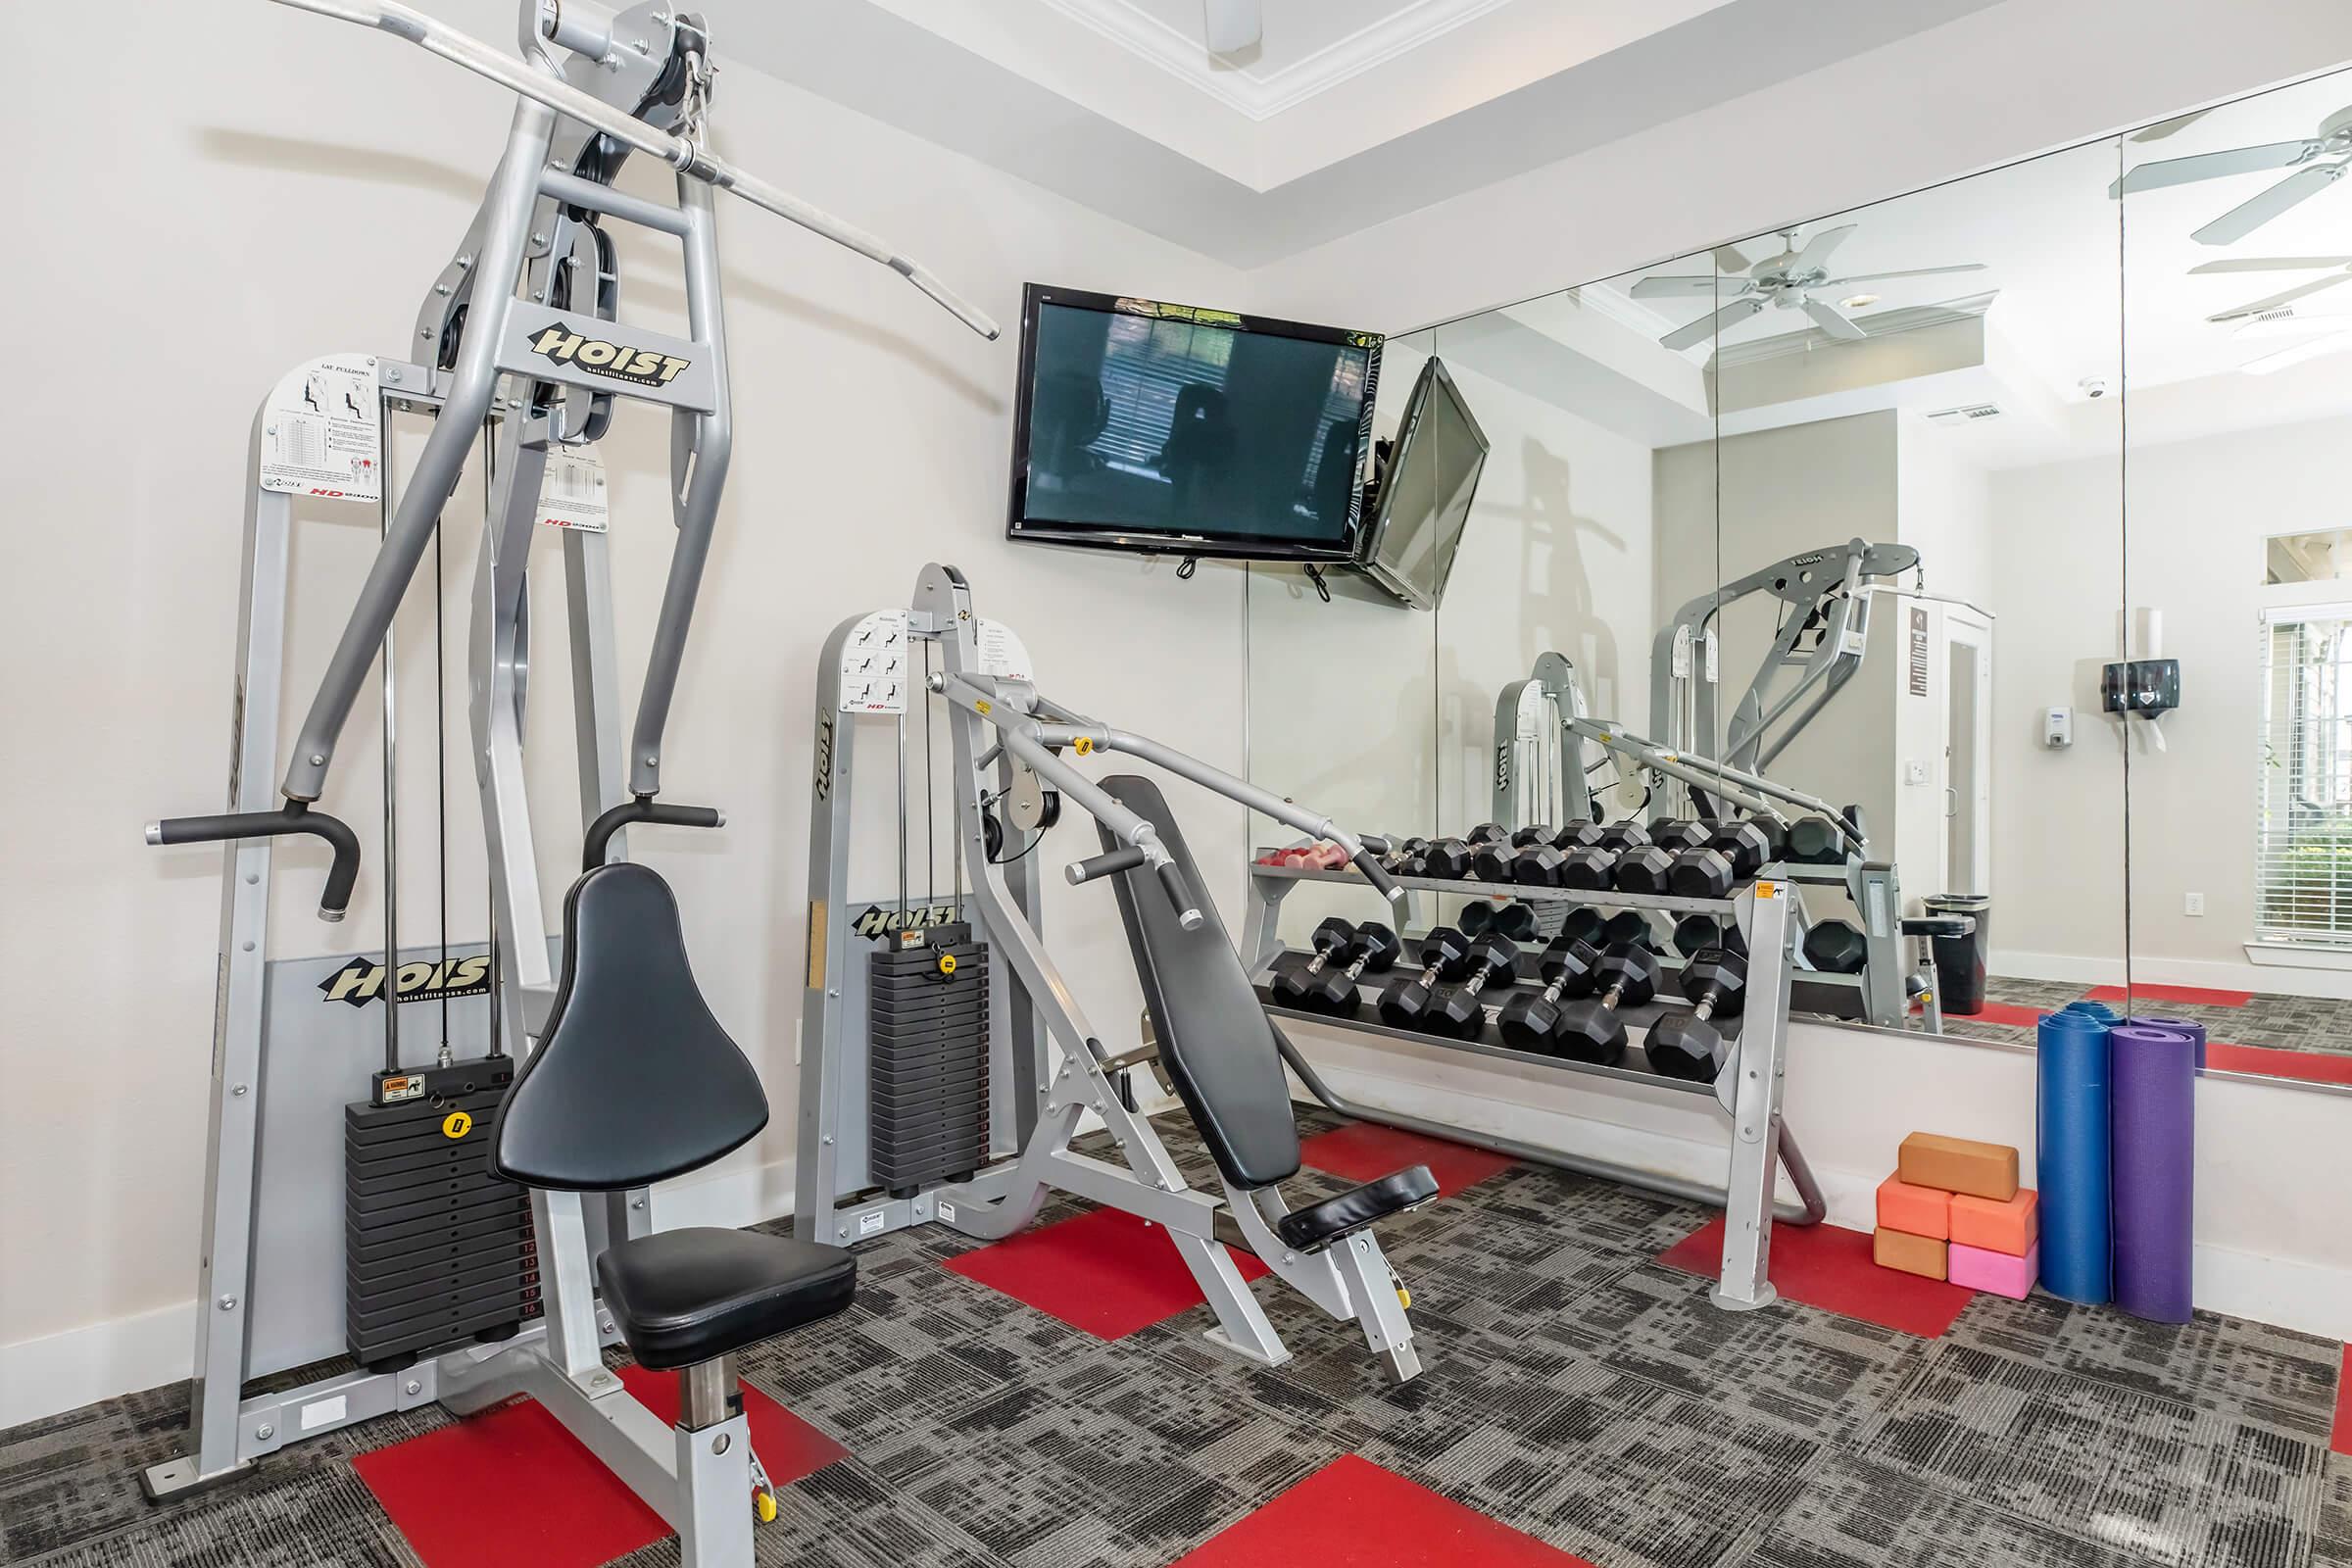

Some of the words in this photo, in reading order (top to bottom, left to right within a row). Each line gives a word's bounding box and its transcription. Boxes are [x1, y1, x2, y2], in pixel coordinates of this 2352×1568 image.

[532, 328, 691, 382] HOIST
[587, 367, 658, 386] hoistfitness.com
[816, 708, 833, 801] HOIST
[326, 955, 496, 1002] HOIS
